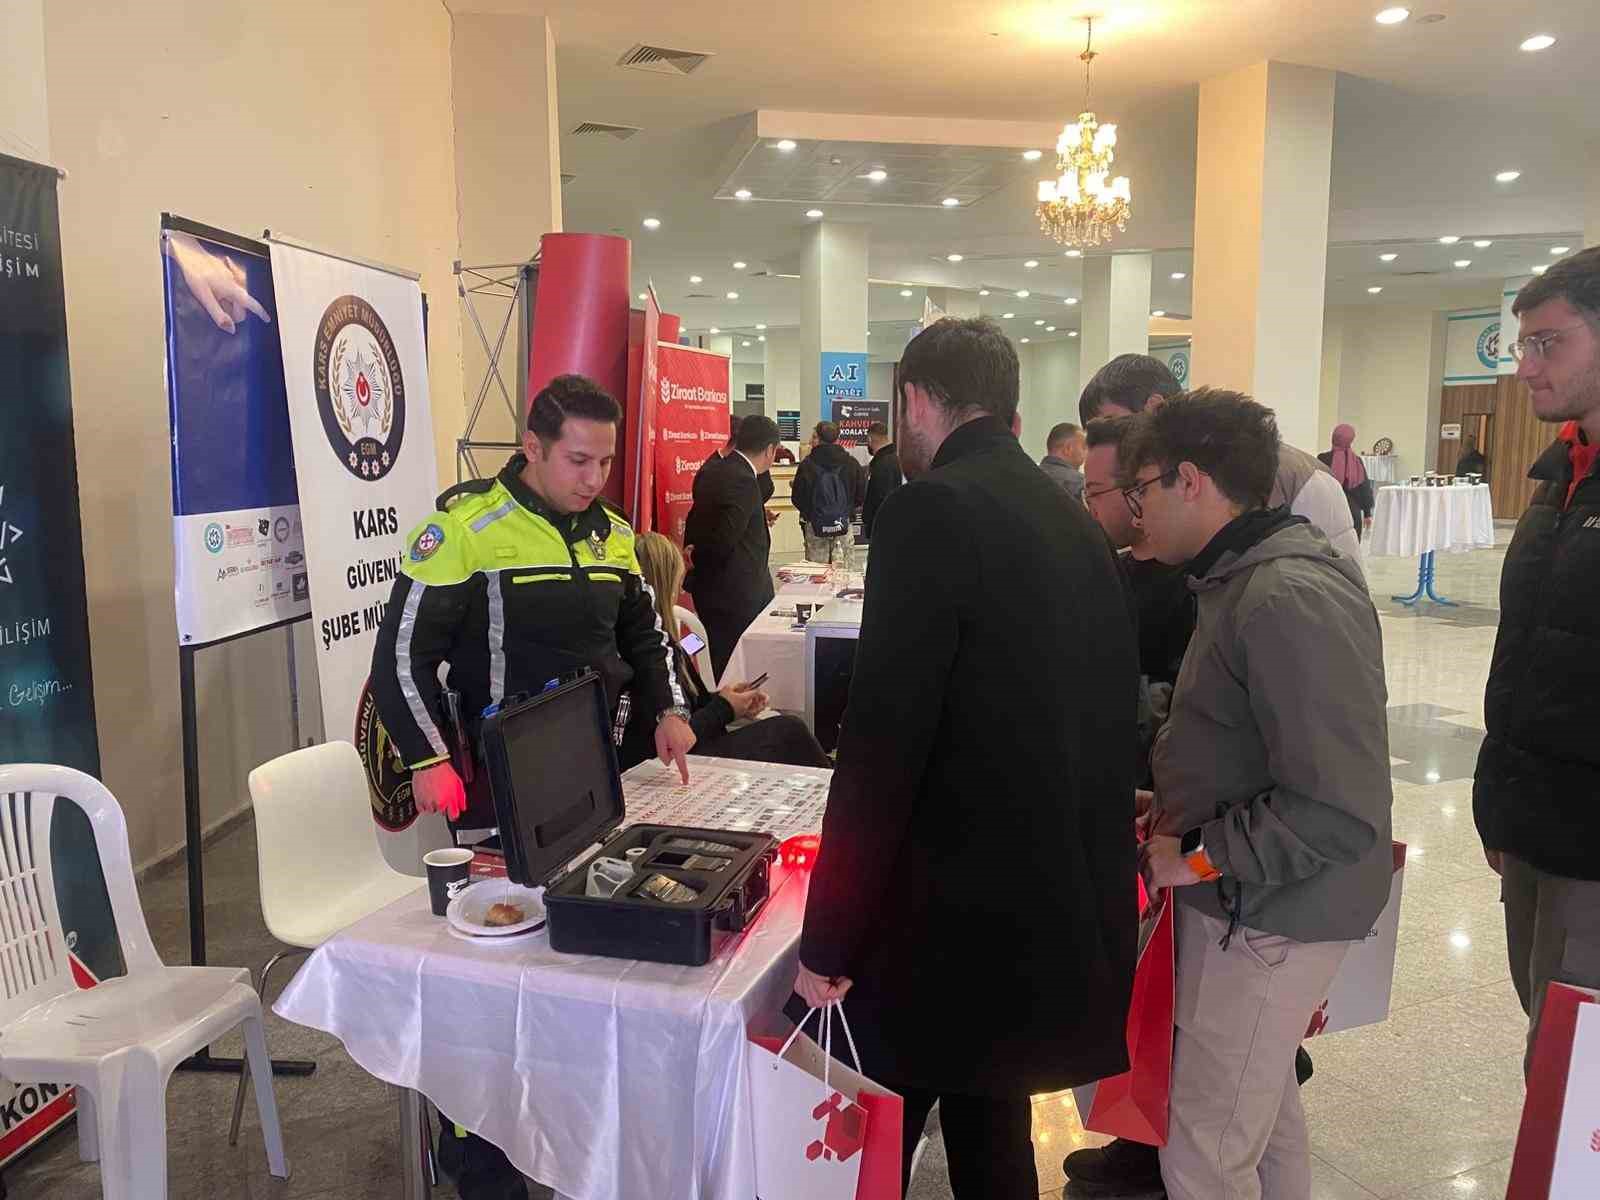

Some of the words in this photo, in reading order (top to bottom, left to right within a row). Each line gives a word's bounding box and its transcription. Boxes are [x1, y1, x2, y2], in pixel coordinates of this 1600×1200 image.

[829, 363, 859, 382] AI
[670, 384, 698, 402] Ziraat
[353, 506, 399, 540] KARS
[346, 551, 405, 590] GÜVENLİ
[321, 611, 361, 651] ŞUBE
[363, 600, 391, 632] MÜ
[0, 1083, 72, 1130] KON
